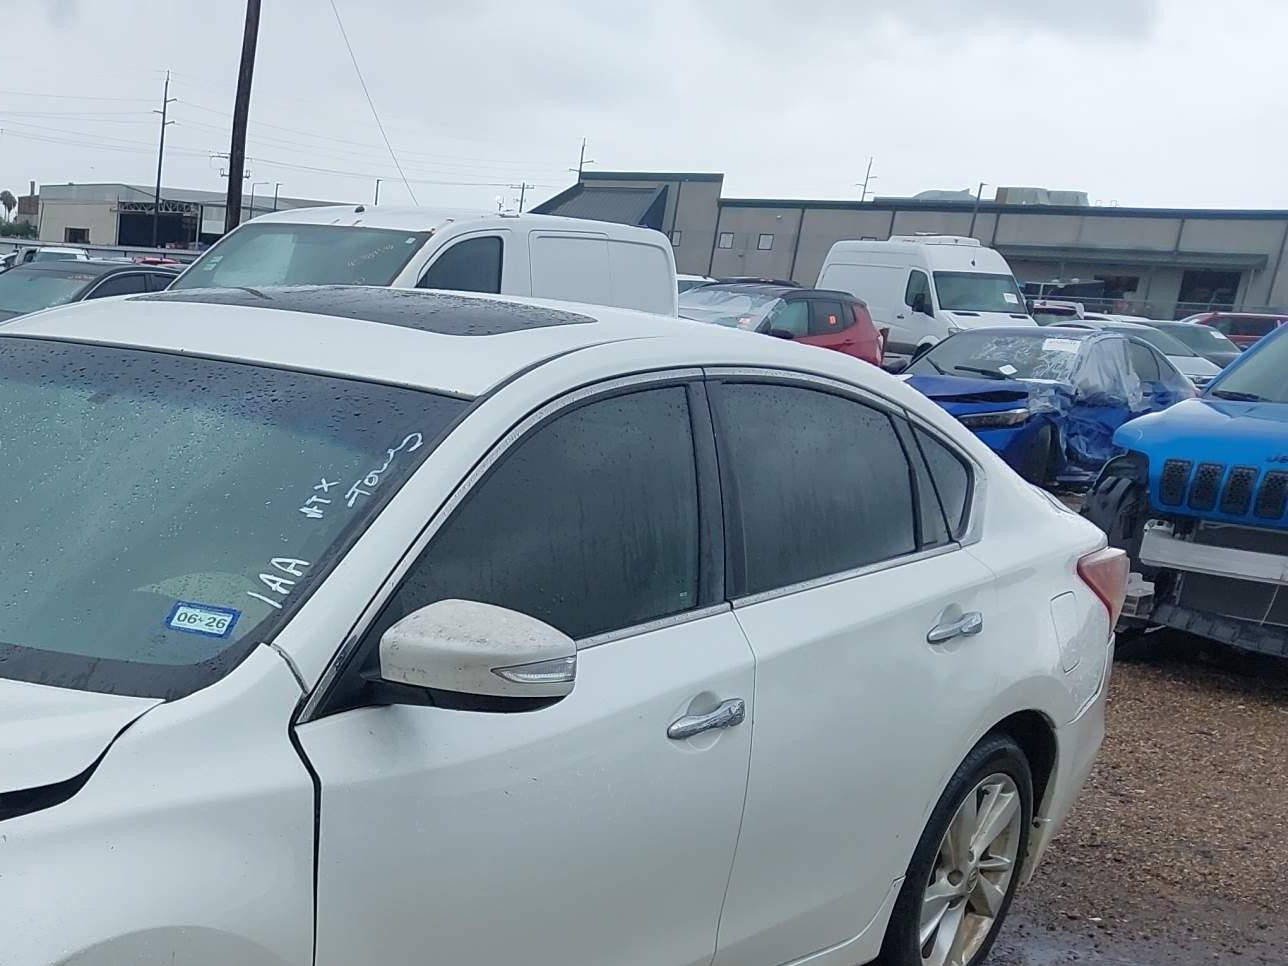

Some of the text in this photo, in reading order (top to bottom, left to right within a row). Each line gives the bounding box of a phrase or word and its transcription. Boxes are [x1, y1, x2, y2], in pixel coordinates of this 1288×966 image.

[247, 557, 312, 610] IAA
[176, 611, 229, 630] 06 26
